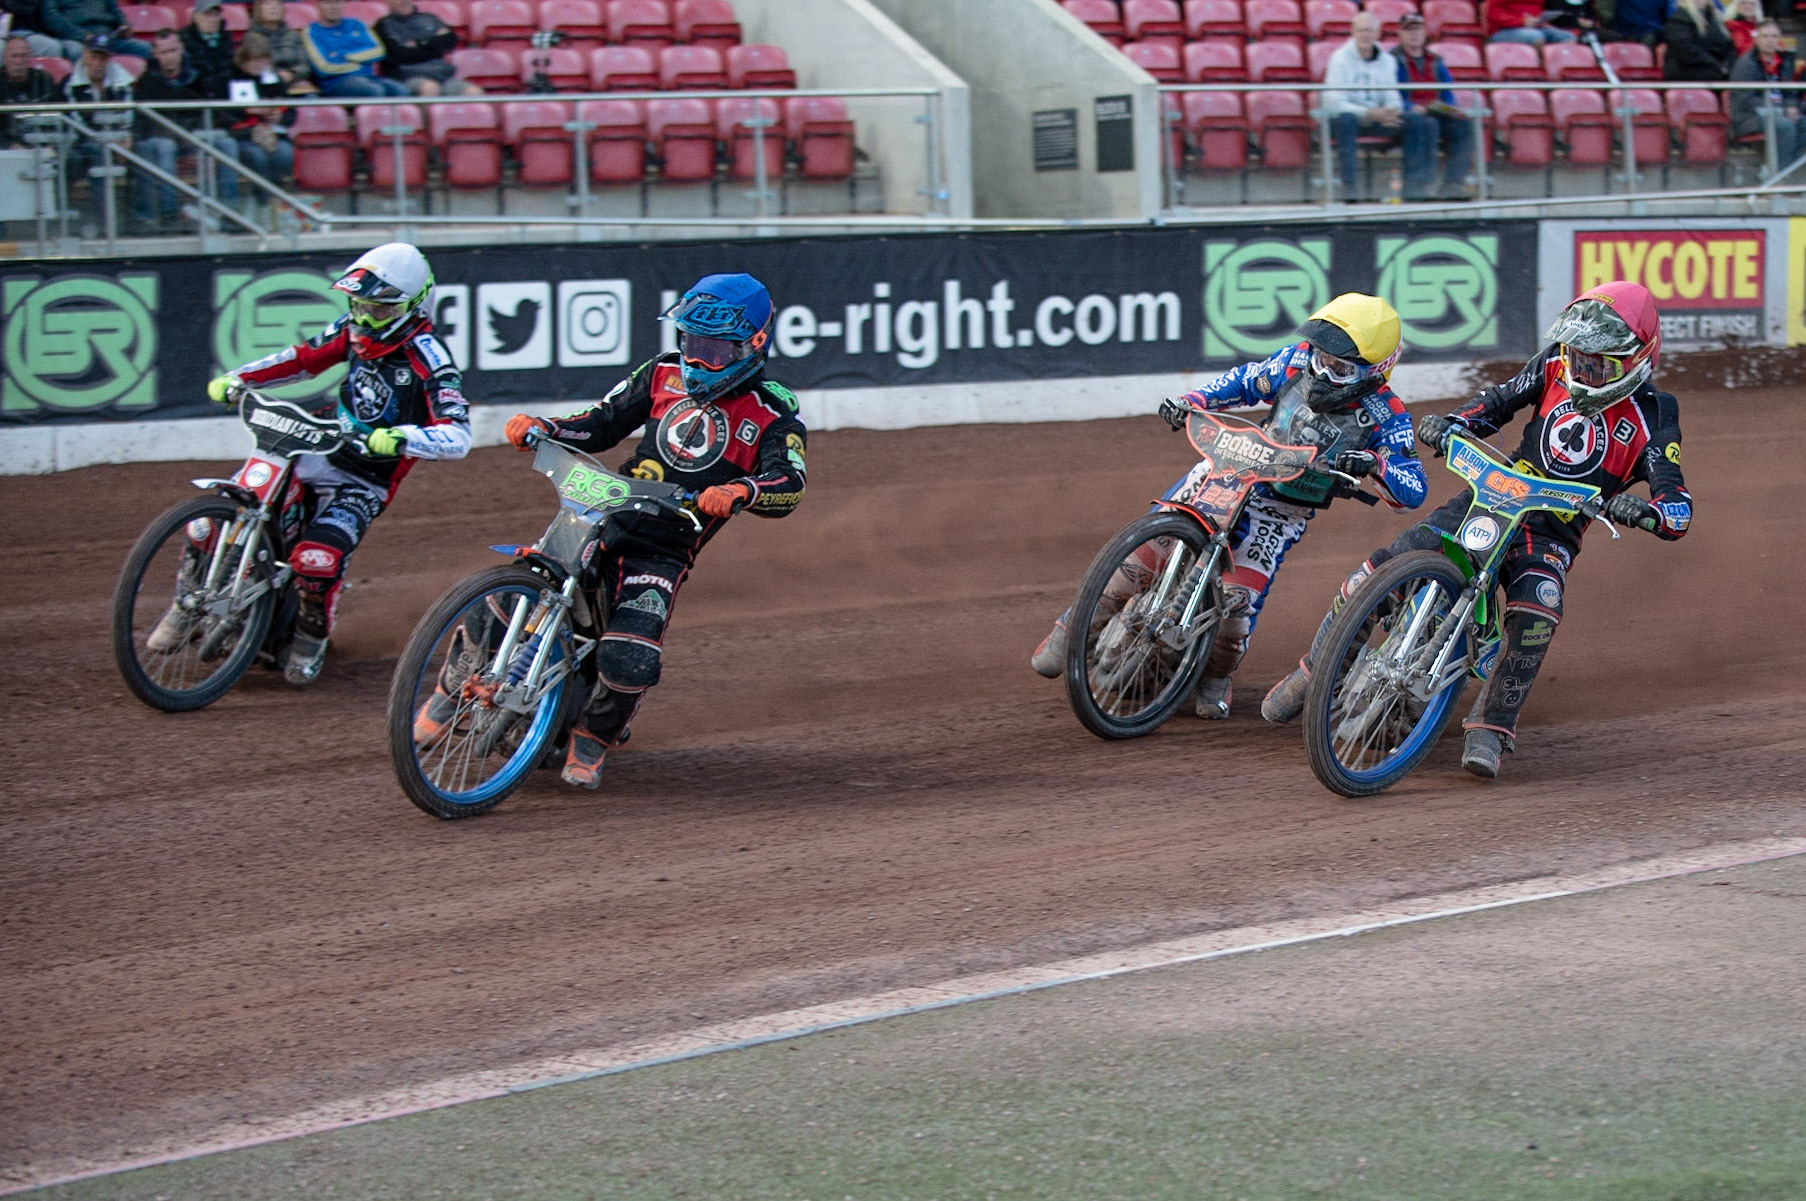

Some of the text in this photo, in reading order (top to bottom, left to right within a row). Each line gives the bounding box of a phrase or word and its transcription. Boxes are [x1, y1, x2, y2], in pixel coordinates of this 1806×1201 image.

[1581, 239, 1759, 300] HYCOTE
[661, 280, 1182, 369] e-right.com
[1298, 408, 1336, 438] PIRATES
[1358, 409, 1369, 424] 6
[1553, 402, 1605, 452] BELL ACES
[741, 424, 753, 441] 6
[1617, 422, 1631, 441] 3
[1218, 431, 1275, 463] BORGE
[1459, 446, 1488, 472] ALBON
[561, 464, 631, 508] RIGO
[1485, 470, 1532, 501] CFS
[1467, 526, 1492, 542] ATPI
[623, 573, 674, 593] MOTUL
[1522, 633, 1542, 641] ROCK
